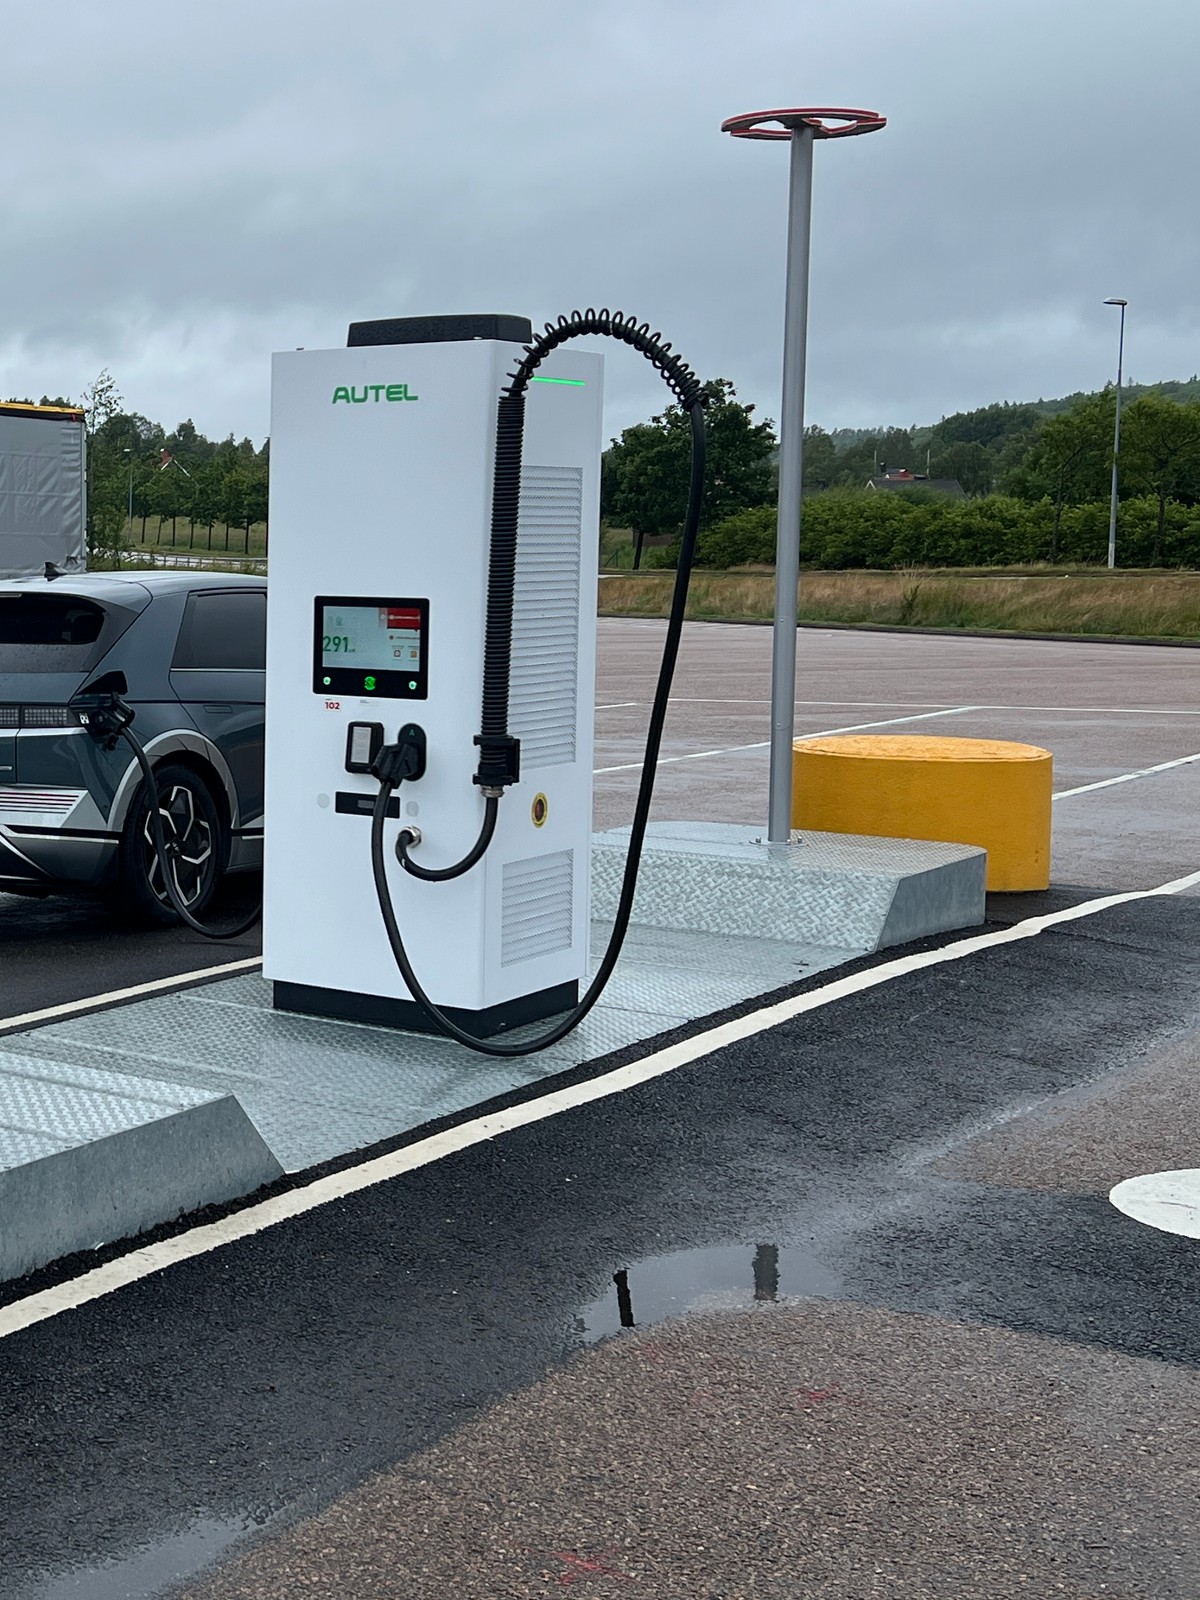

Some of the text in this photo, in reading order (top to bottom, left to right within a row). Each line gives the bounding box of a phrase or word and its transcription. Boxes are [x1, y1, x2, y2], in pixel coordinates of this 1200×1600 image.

[332, 384, 419, 404] AUTEL
[322, 636, 348, 652] 291
[325, 702, 340, 710] 102
